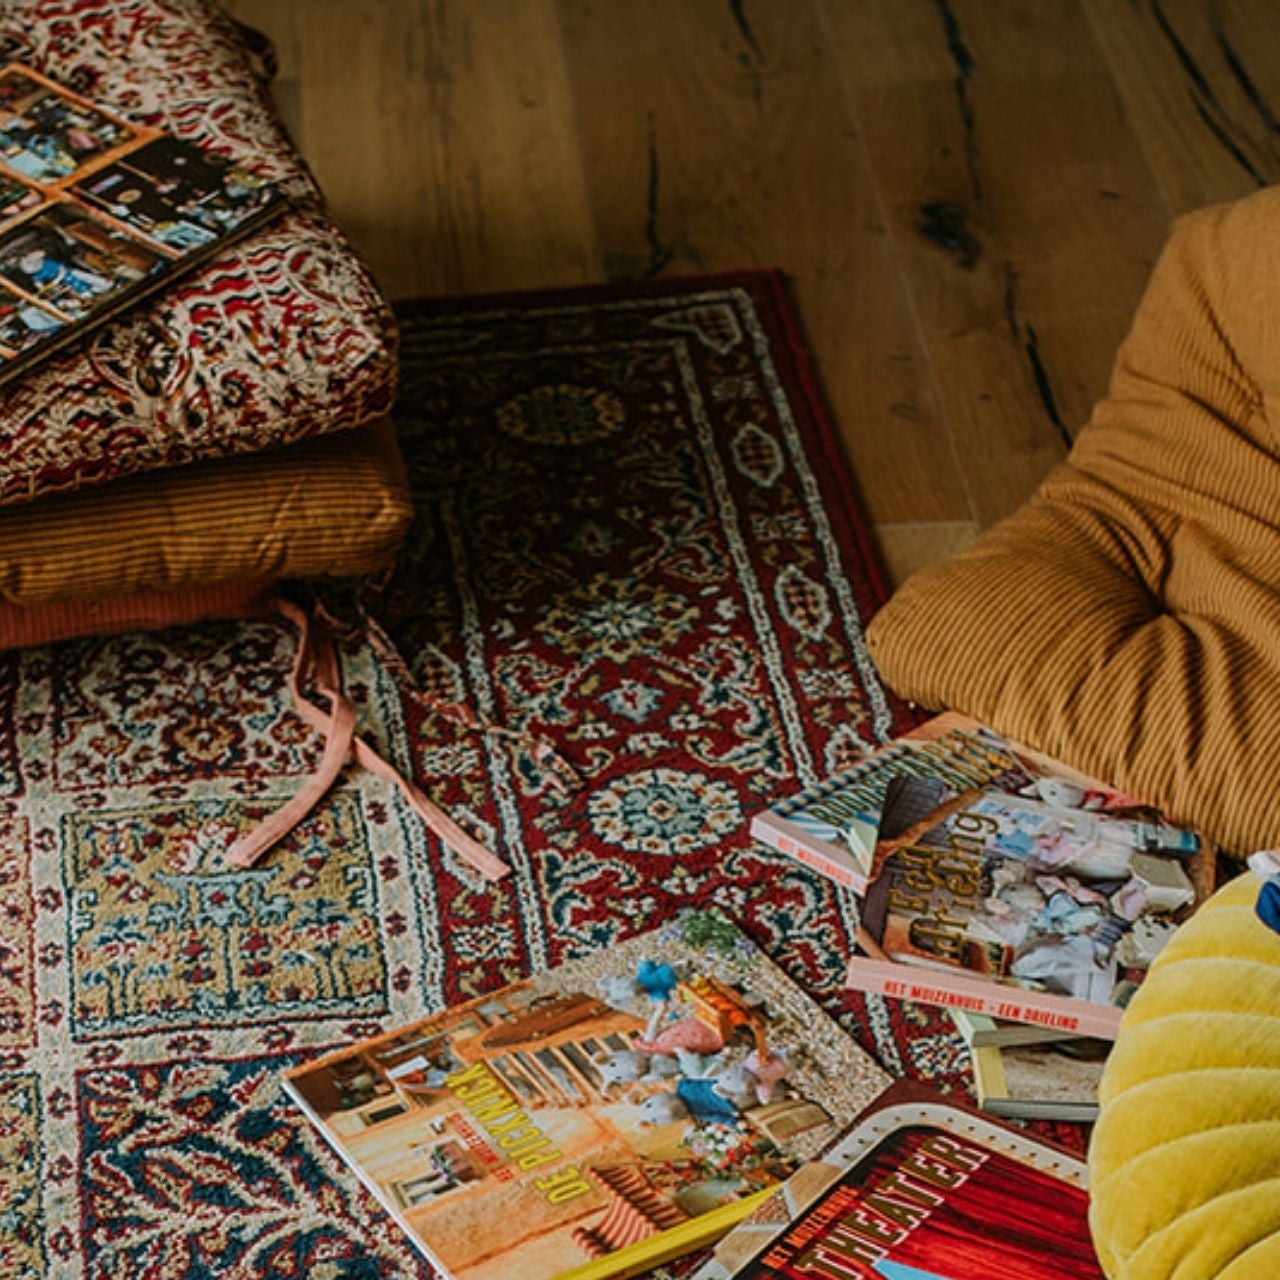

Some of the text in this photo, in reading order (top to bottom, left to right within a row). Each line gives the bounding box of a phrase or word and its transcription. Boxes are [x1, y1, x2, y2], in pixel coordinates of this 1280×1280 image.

[883, 980, 905, 996] HET
[910, 985, 985, 1011] MUIZENHUIS
[998, 1003, 1020, 1018] EEN
[1024, 1008, 1079, 1030] DRIELING
[442, 1062, 564, 1171] PICKNICK
[535, 1165, 592, 1205] DE
[760, 1184, 860, 1270] HET MUIZENHUIS
